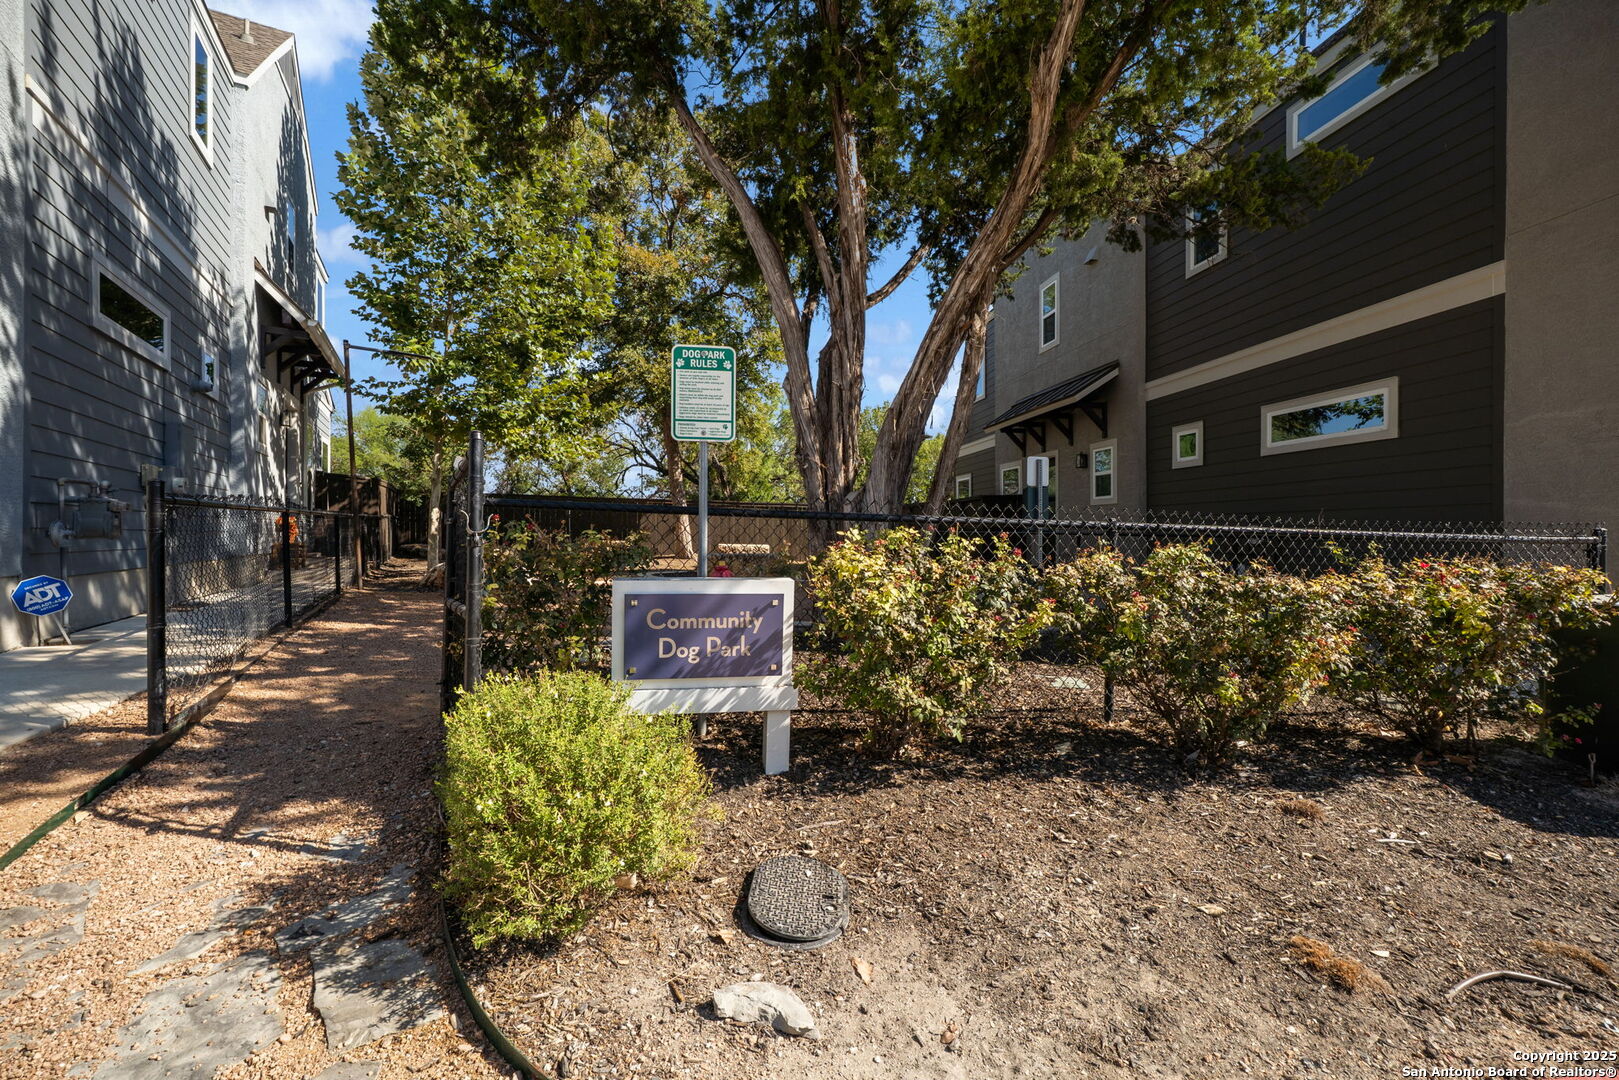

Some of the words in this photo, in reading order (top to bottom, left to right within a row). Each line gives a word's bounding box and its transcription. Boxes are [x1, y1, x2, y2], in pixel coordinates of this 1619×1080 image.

[682, 350, 700, 358] DOG
[690, 359, 718, 368] RULES
[24, 583, 60, 607] ADT
[646, 608, 763, 634] Community
[658, 637, 700, 664] Dog
[706, 635, 751, 657] Park
